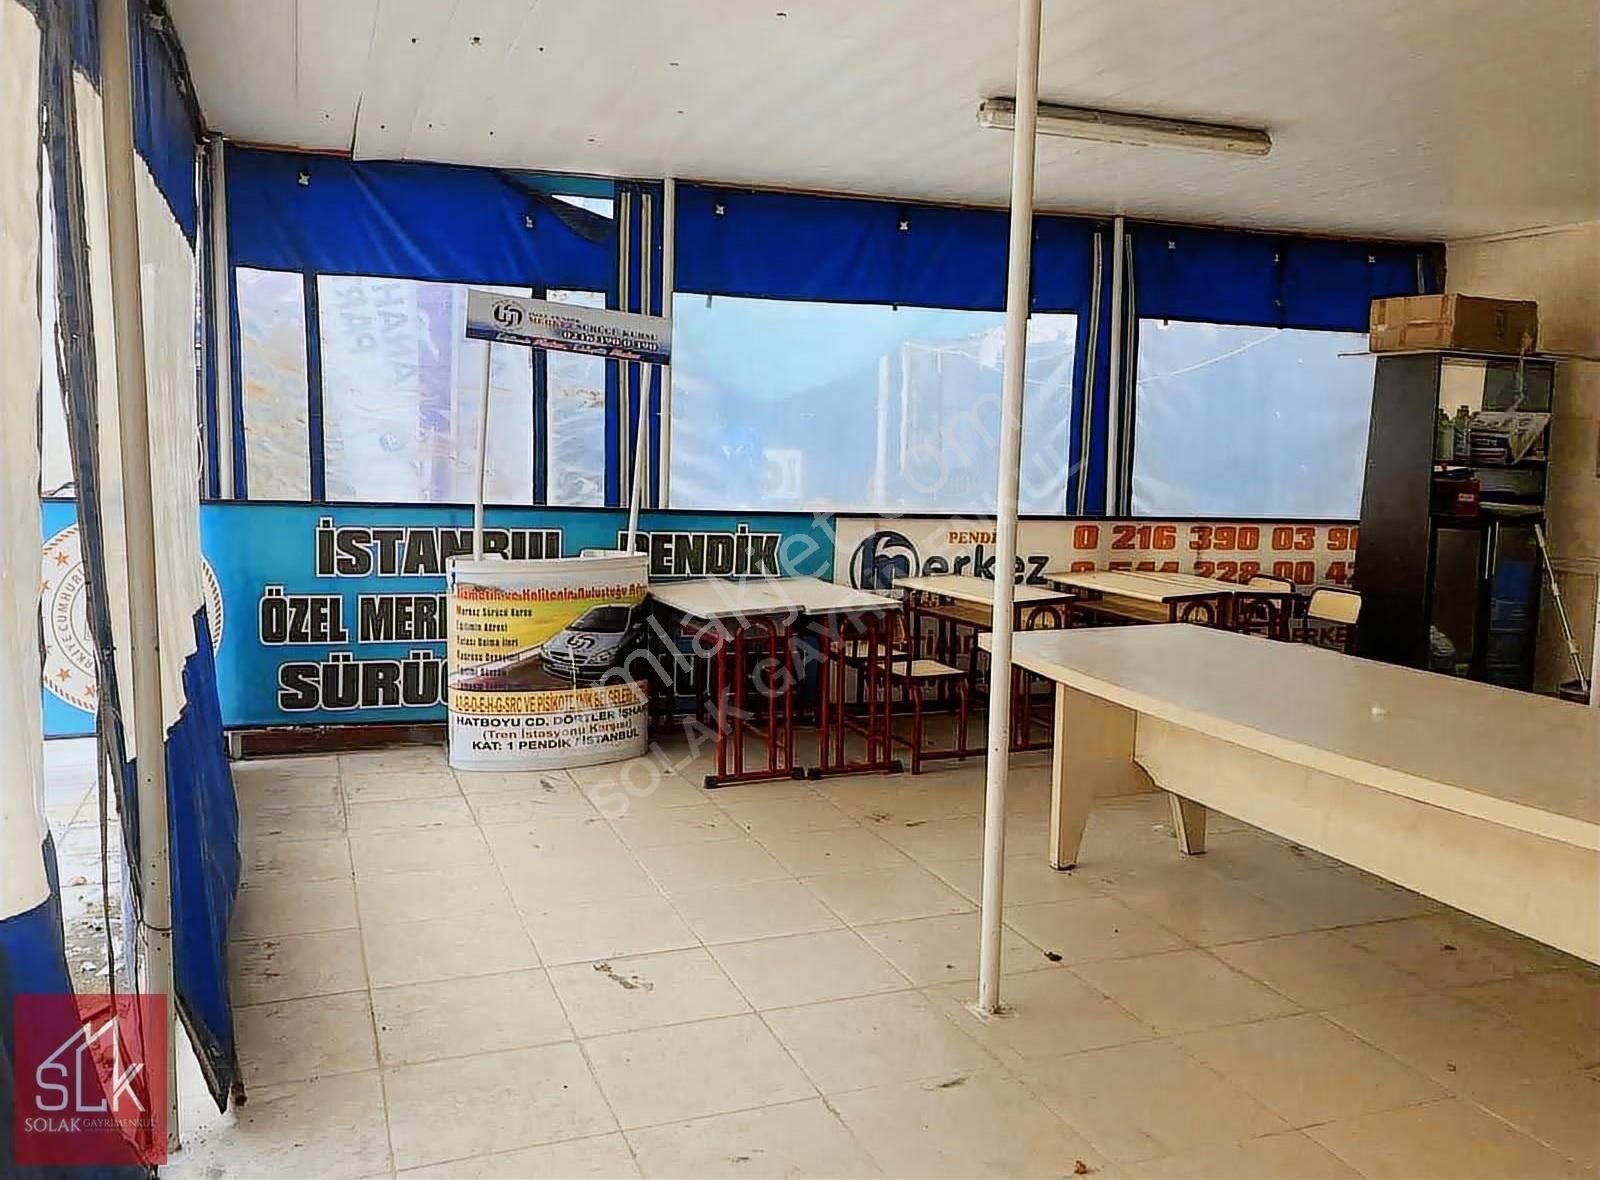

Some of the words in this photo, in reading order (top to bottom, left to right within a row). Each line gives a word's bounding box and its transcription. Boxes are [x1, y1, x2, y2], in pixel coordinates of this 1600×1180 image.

[1073, 525, 1098, 550] 0
[1112, 525, 1176, 550] 216
[1189, 526, 1260, 550] 390
[1271, 527, 1315, 550] 03
[259, 585, 349, 645] ÖZEL
[456, 716, 521, 728] HATBOYU
[524, 716, 550, 728] CD.
[472, 741, 502, 751] KAT:
[518, 738, 573, 751] PENDİK
[582, 729, 640, 747] İSTANBUL
